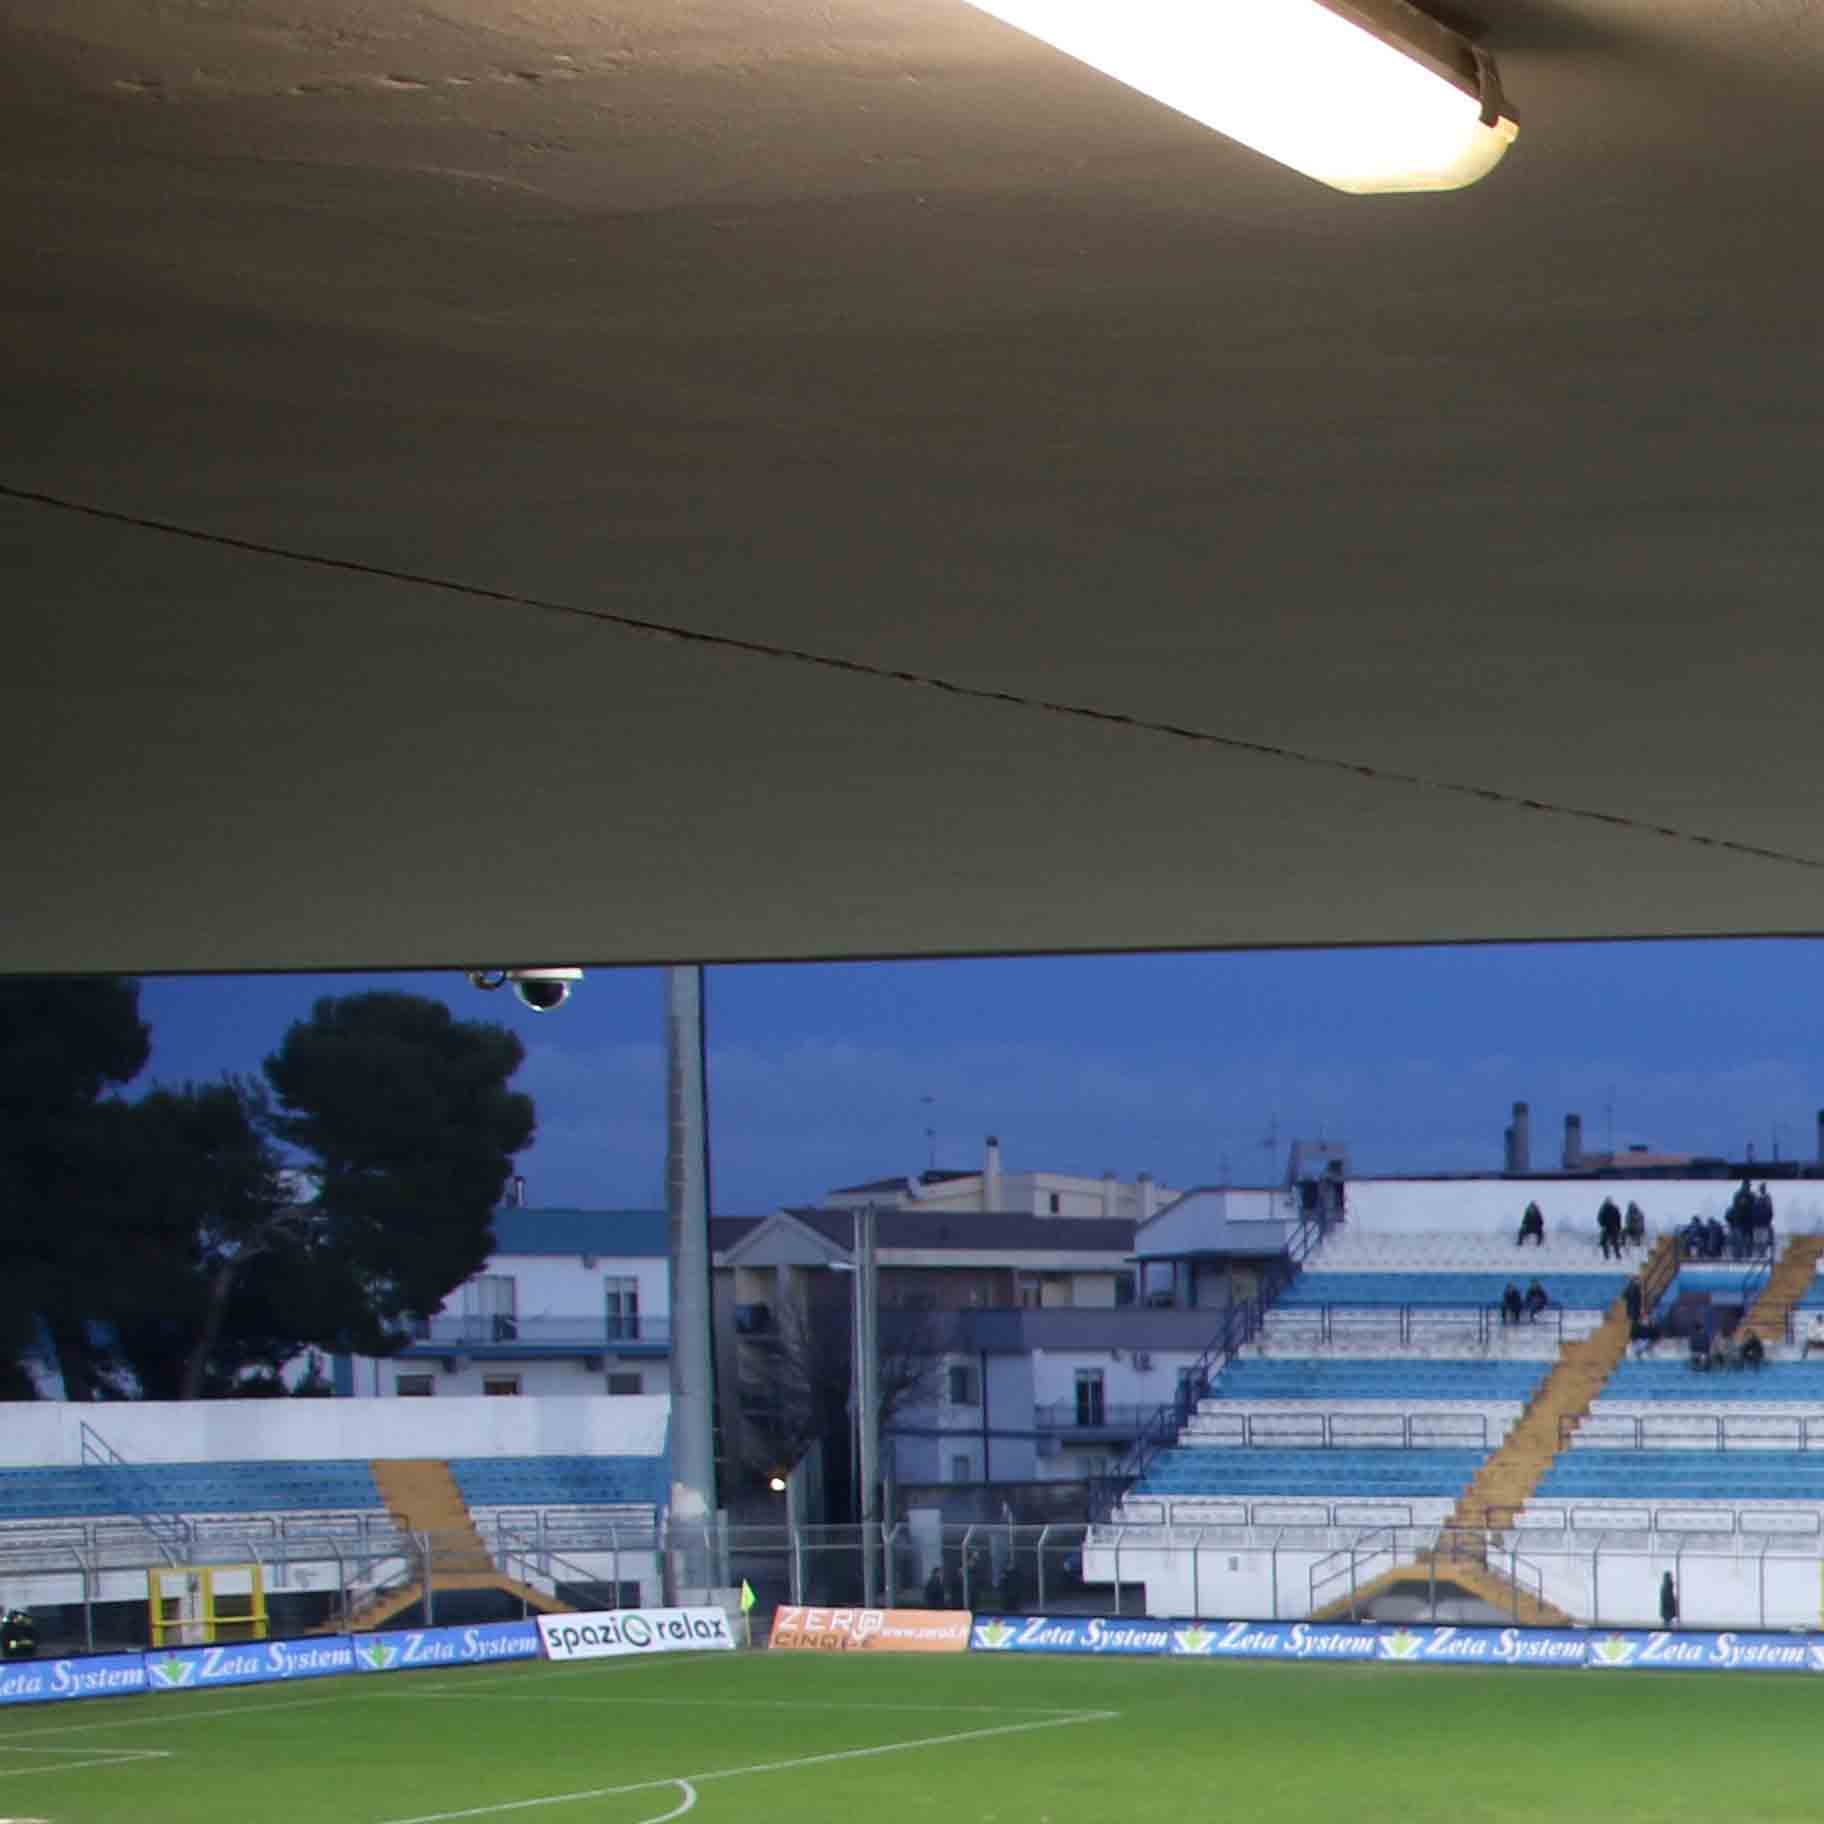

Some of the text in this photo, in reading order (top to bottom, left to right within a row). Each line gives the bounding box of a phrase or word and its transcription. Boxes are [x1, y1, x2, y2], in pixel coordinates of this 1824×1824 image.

[657, 1610, 726, 1640] relax
[1016, 1617, 1168, 1652] Zeta System
[1218, 1621, 1376, 1657] Zeta System
[200, 1641, 352, 1679] Zeta System
[402, 1629, 537, 1664] Zeta System
[1424, 1626, 1584, 1662] Zeta System
[1641, 1631, 1805, 1666] Zeta System
[52, 1659, 144, 1696] System
